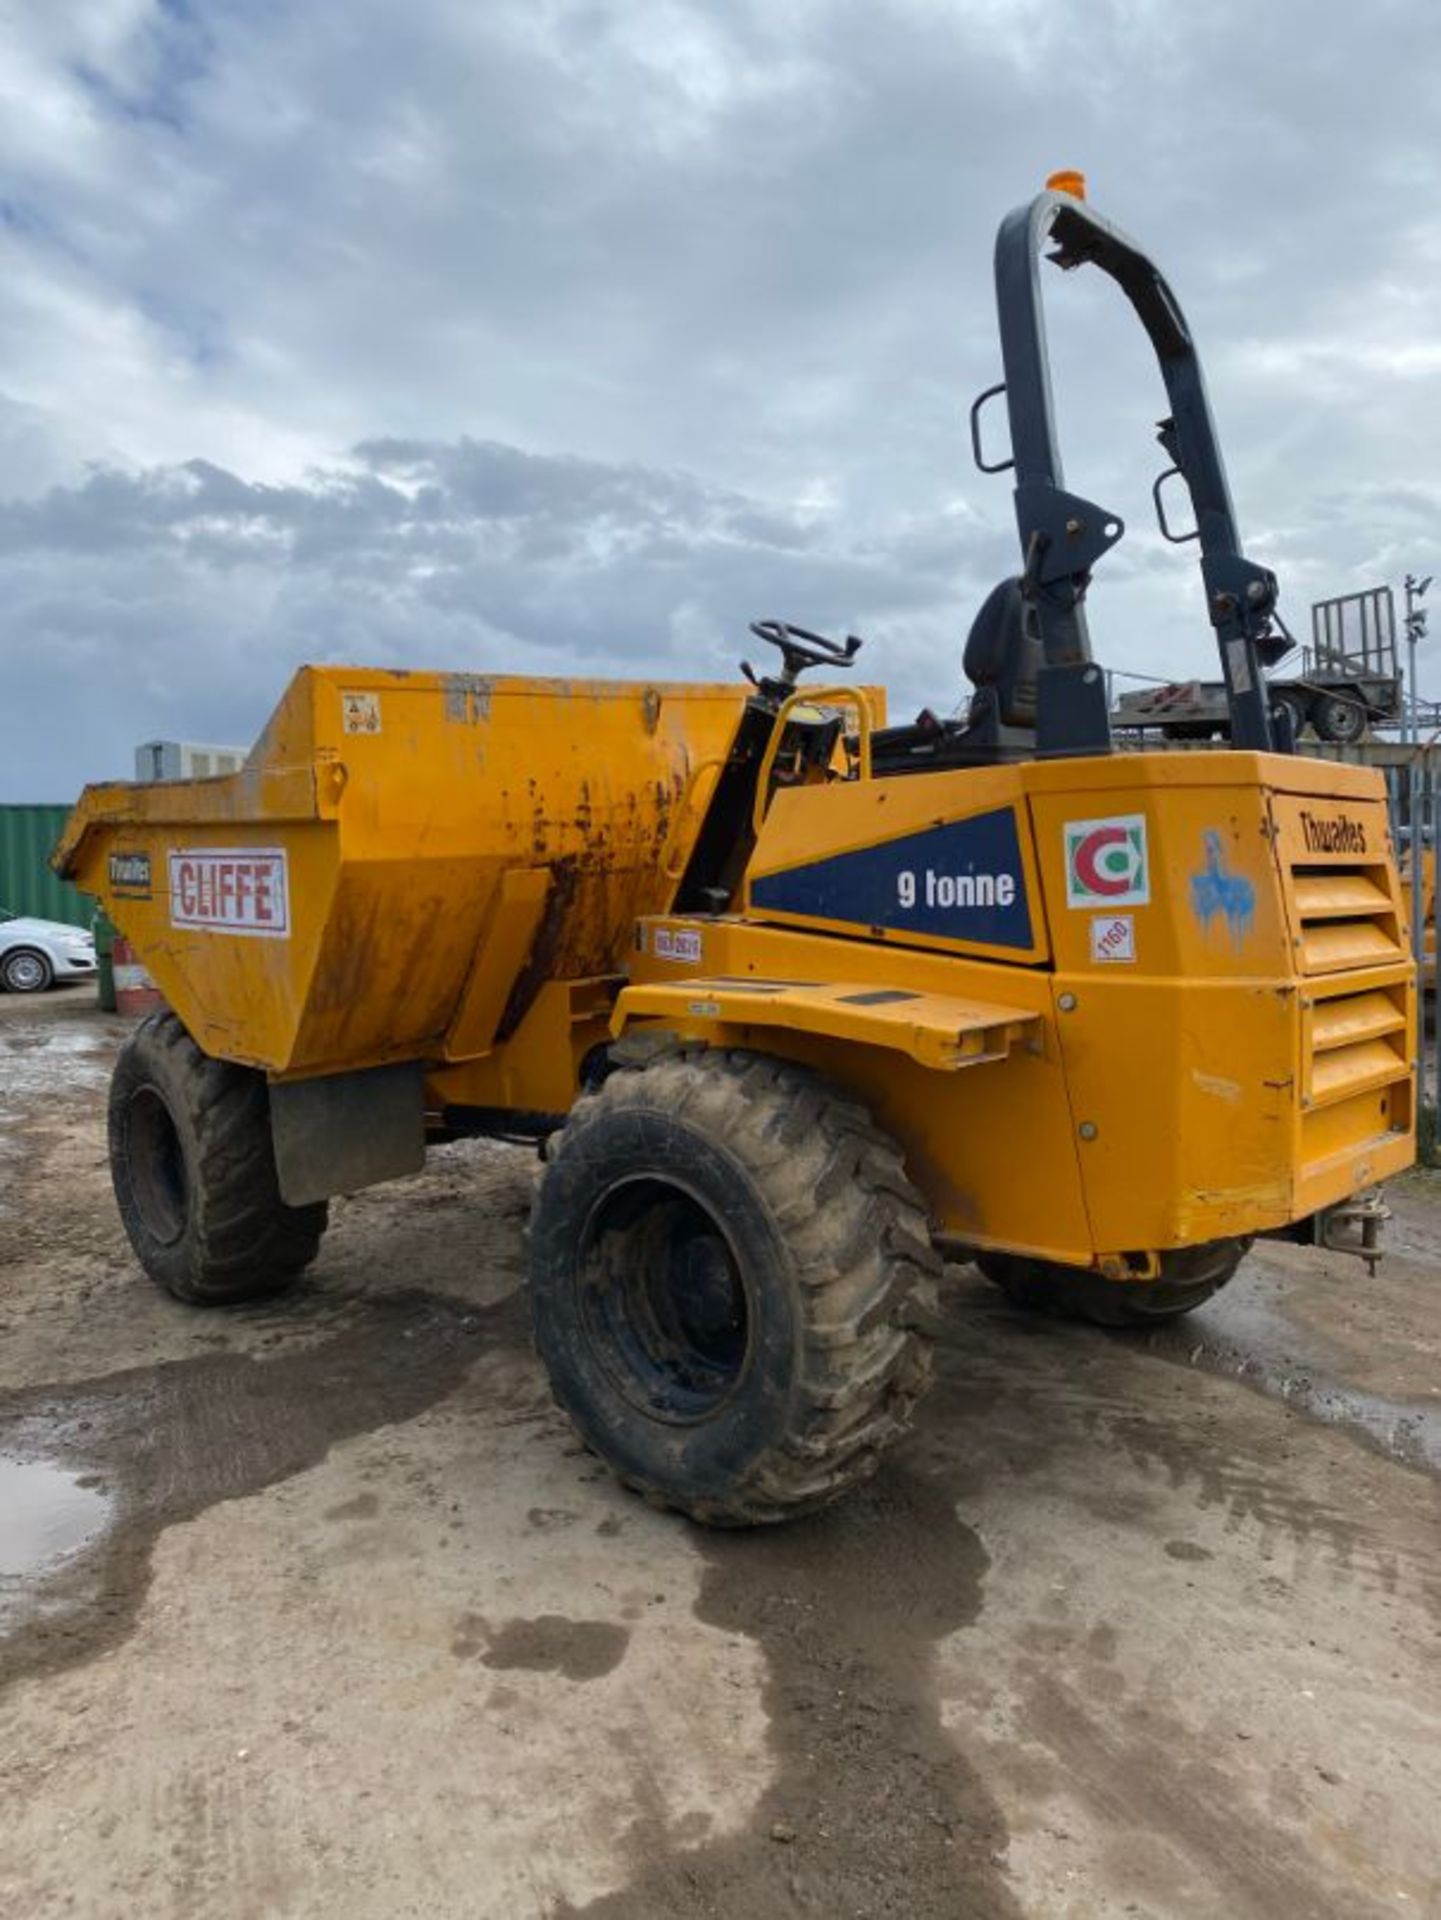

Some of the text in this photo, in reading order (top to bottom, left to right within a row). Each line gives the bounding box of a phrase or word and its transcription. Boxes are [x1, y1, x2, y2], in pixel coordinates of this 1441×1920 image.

[1300, 811, 1367, 854] Thwaites
[178, 861, 273, 921] CLIFFE
[897, 868, 1016, 909] 9 tonne
[1098, 920, 1128, 956] 1160
